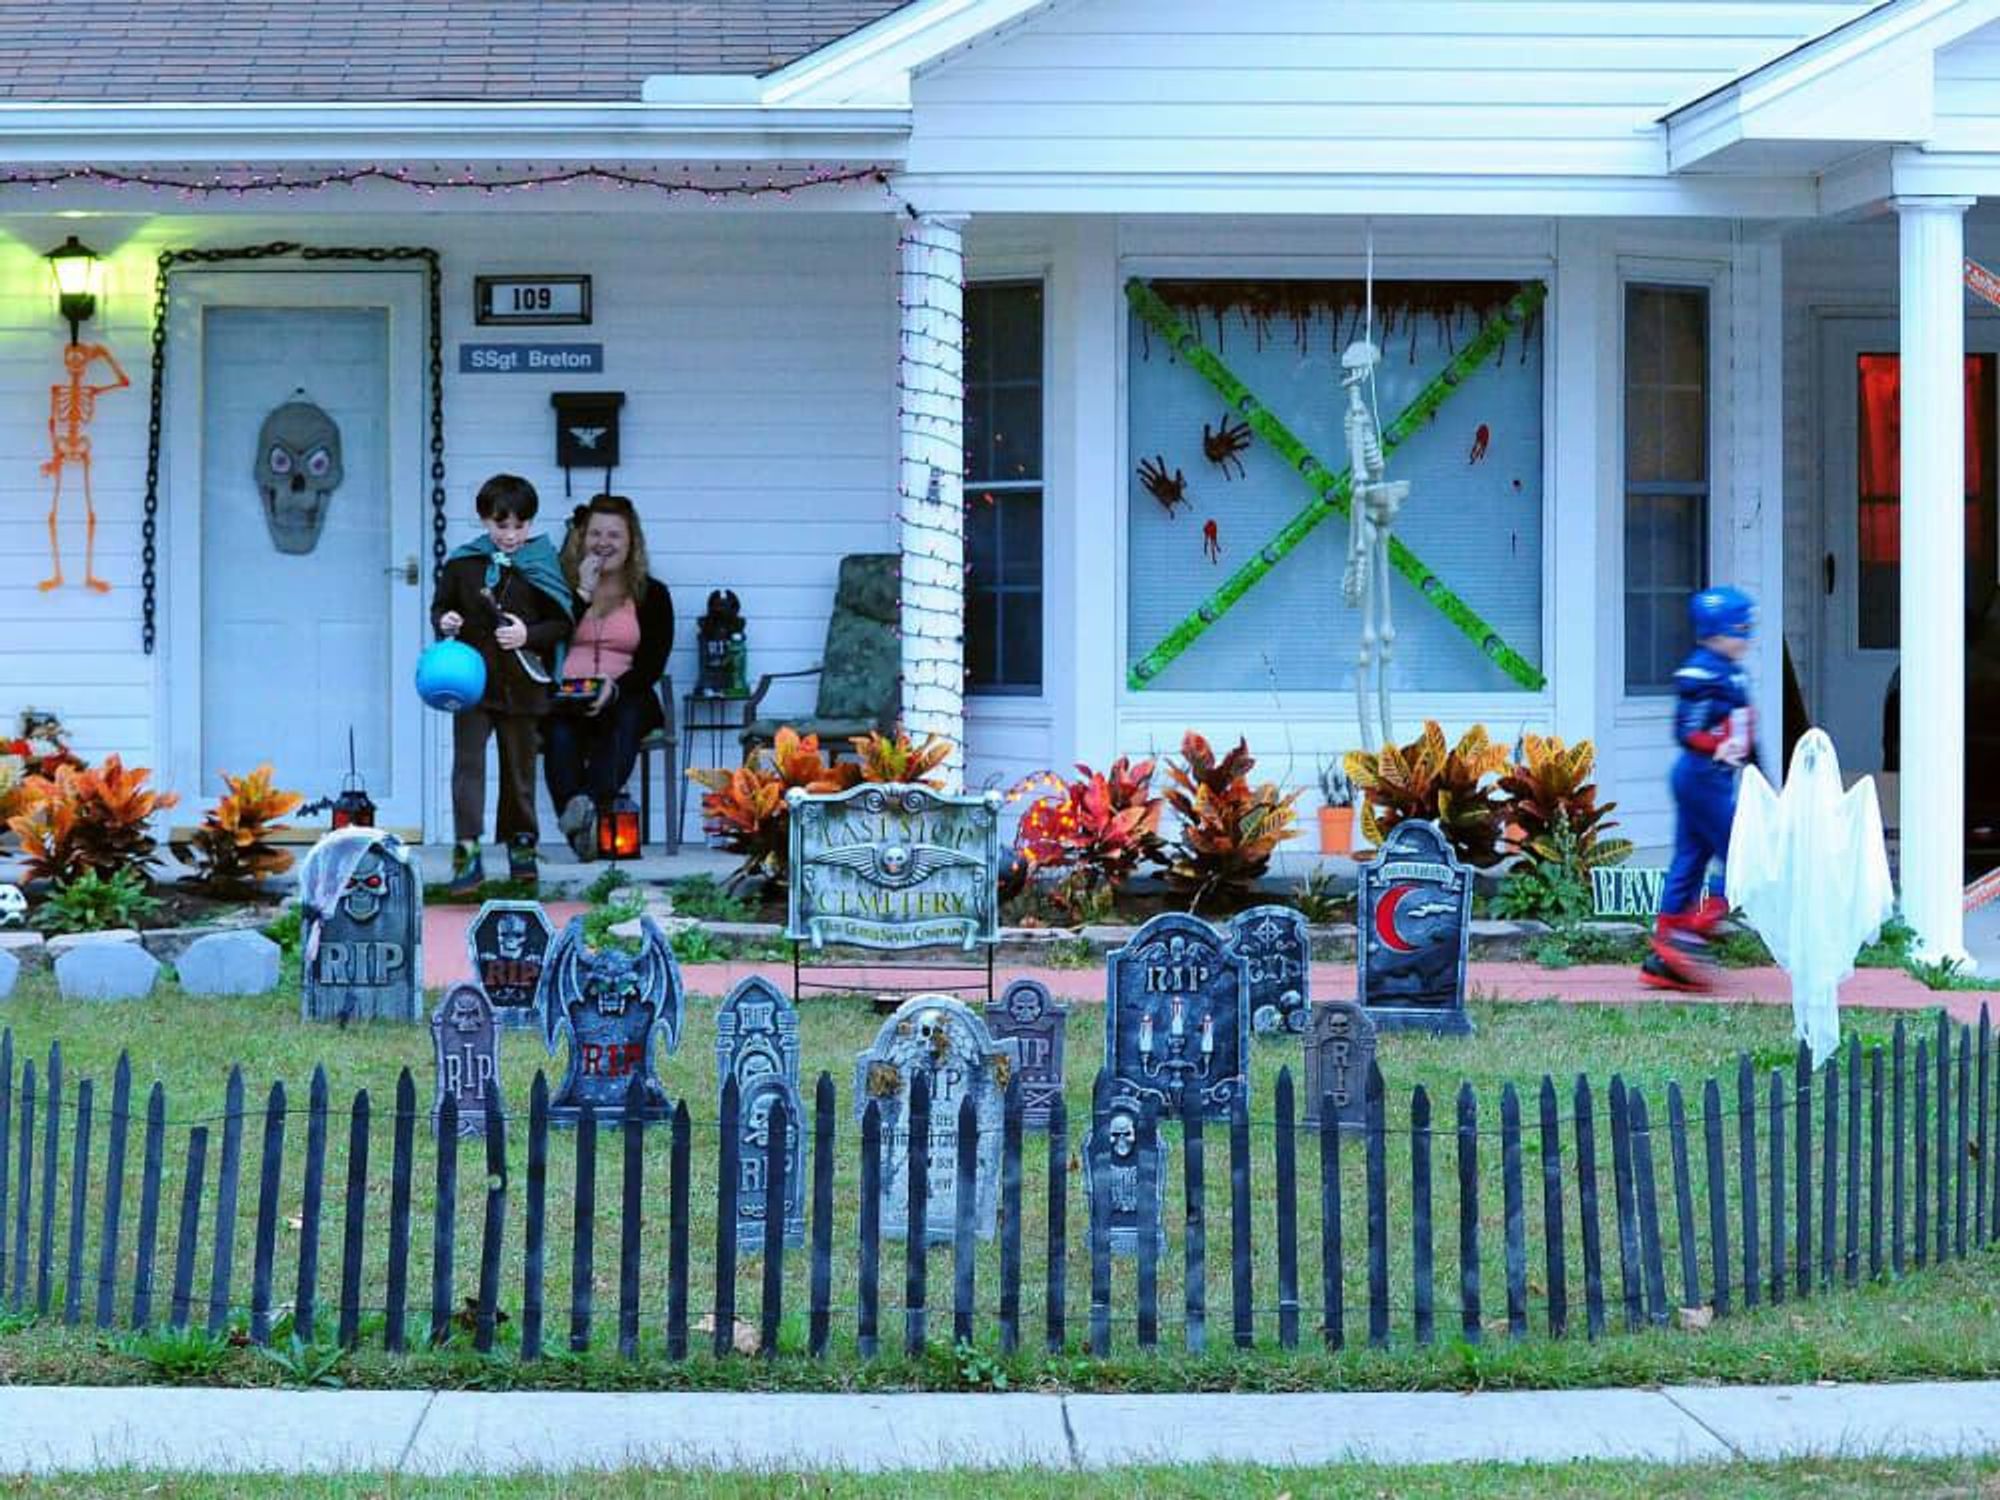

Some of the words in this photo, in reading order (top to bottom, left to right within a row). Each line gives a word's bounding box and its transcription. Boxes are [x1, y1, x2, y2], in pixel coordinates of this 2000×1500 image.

[513, 288, 552, 311] 109
[471, 350, 517, 370] SSgt
[529, 351, 592, 368] Breton
[818, 890, 966, 916] CEMETERY
[1590, 866, 1666, 915] BEW
[320, 942, 404, 986] RIP
[486, 959, 539, 986] RIP
[1147, 965, 1209, 992] RIP
[742, 1006, 770, 1026] RIP
[582, 1038, 643, 1081] RIP
[1020, 1037, 1050, 1068] IP
[446, 1043, 493, 1100] RIP
[928, 1066, 962, 1101] IP
